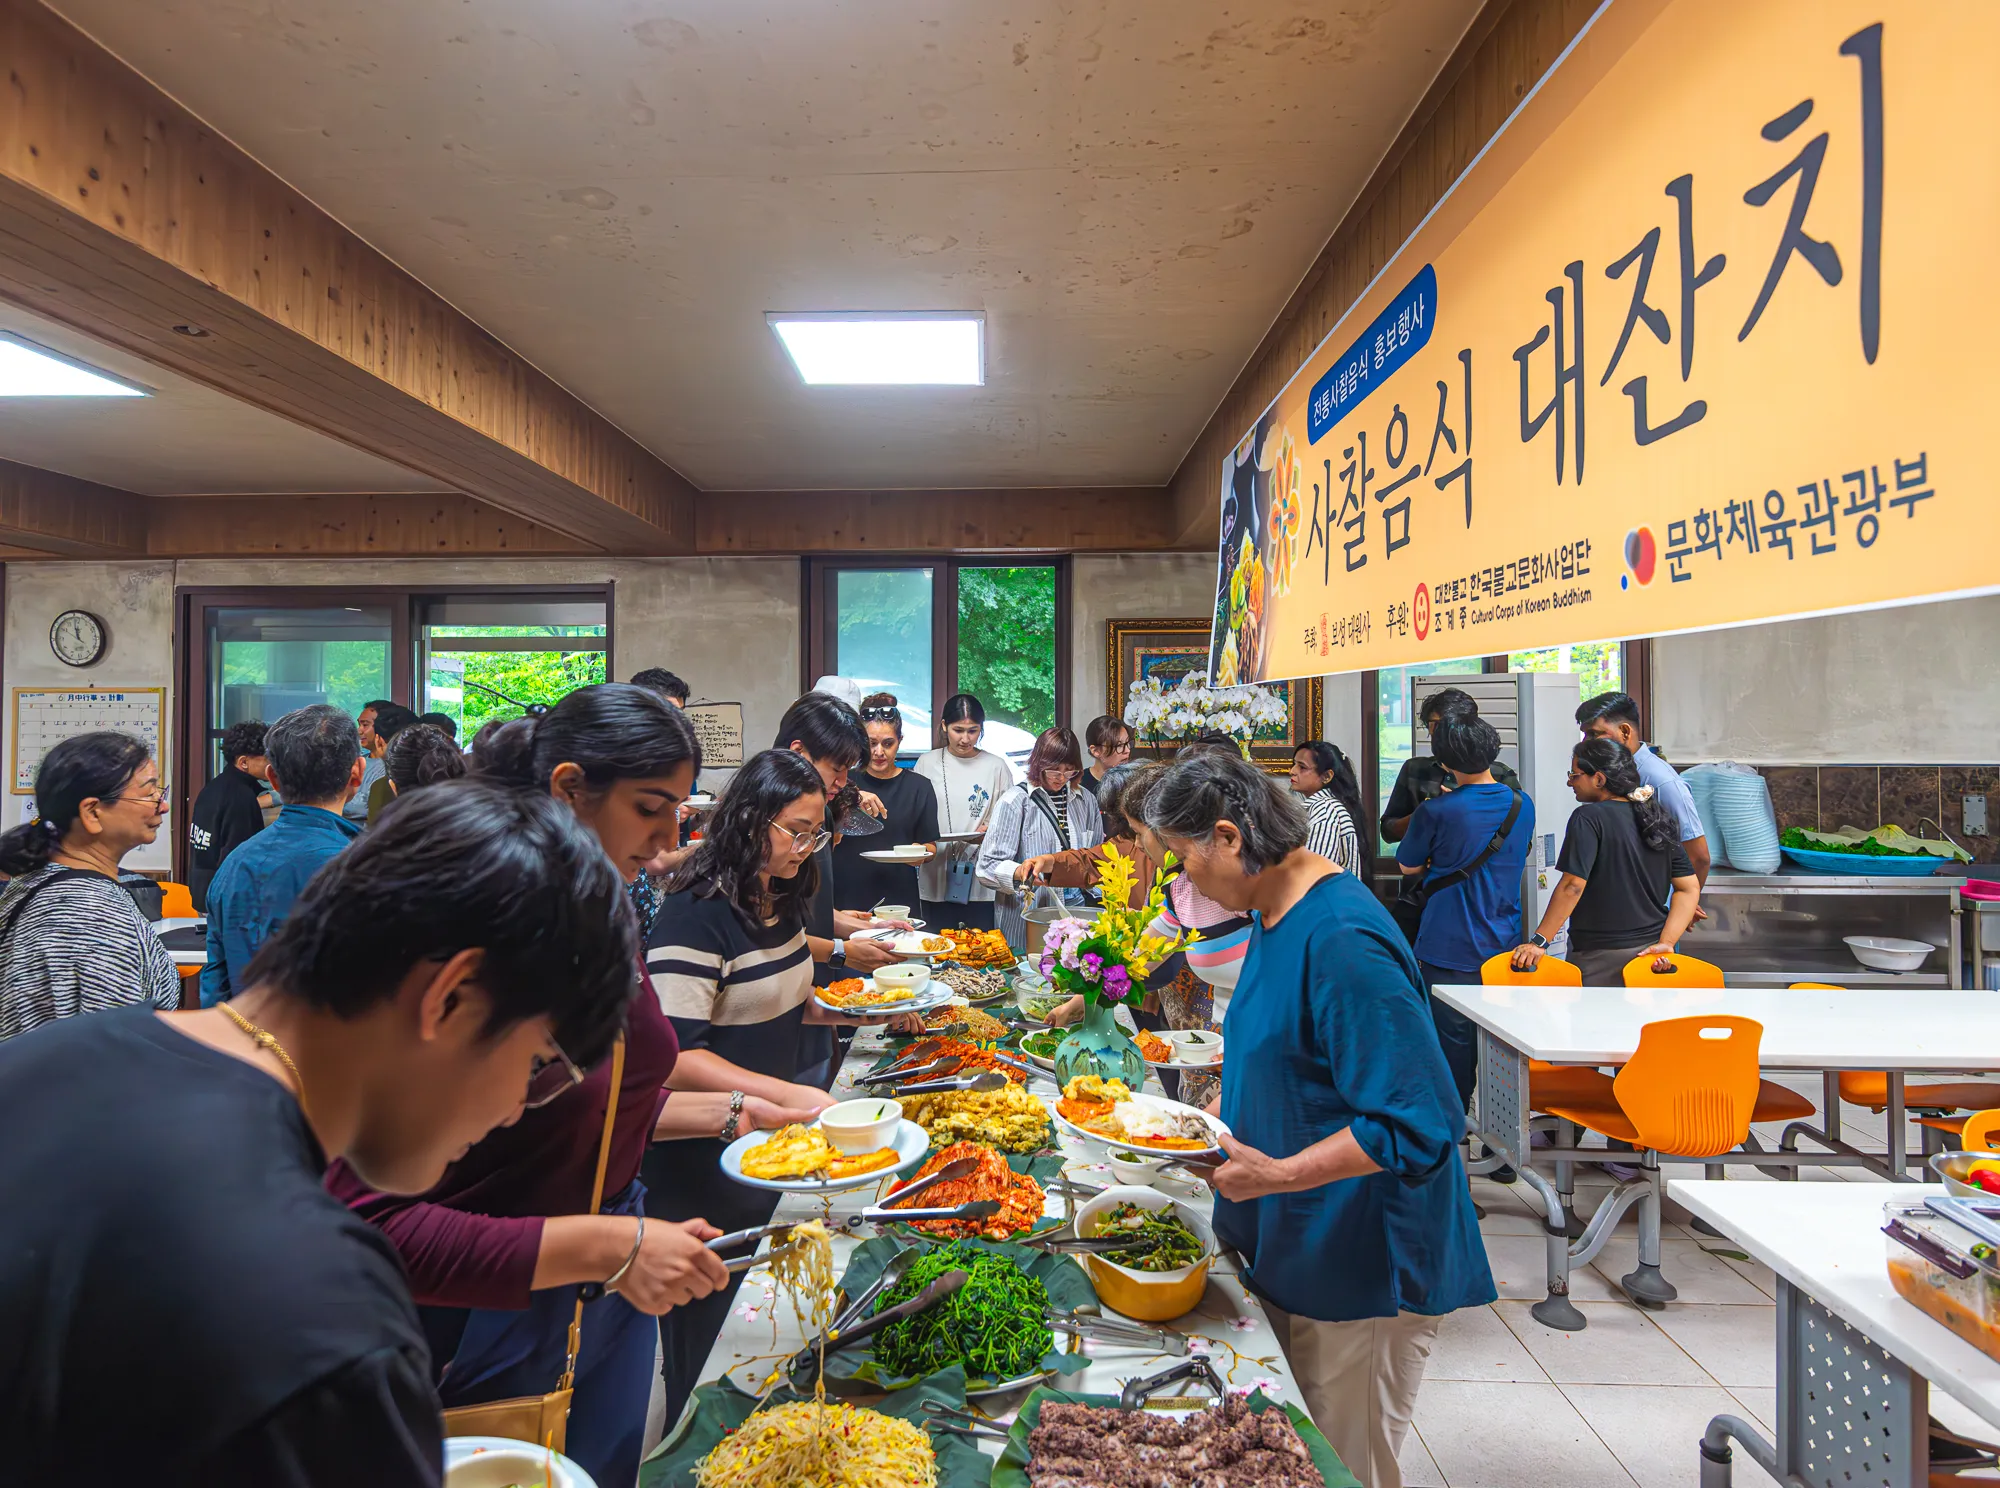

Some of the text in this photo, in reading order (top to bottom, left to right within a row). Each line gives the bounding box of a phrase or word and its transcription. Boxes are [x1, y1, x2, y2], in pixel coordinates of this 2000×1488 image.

[1305, 22, 1884, 587] 사찰음식 대잔치
[1314, 292, 1425, 427] 전통사찰음식 홍보행사
[1665, 451, 1935, 583] 문화체육관광부
[1435, 578, 1467, 604] 대한불교
[1470, 538, 1591, 602] 한국불교문화사업단
[1331, 617, 1346, 647] 보성
[1348, 611, 1371, 645] 대원사
[1471, 588, 1592, 625] Cultural Corps of Korean Buddhism
